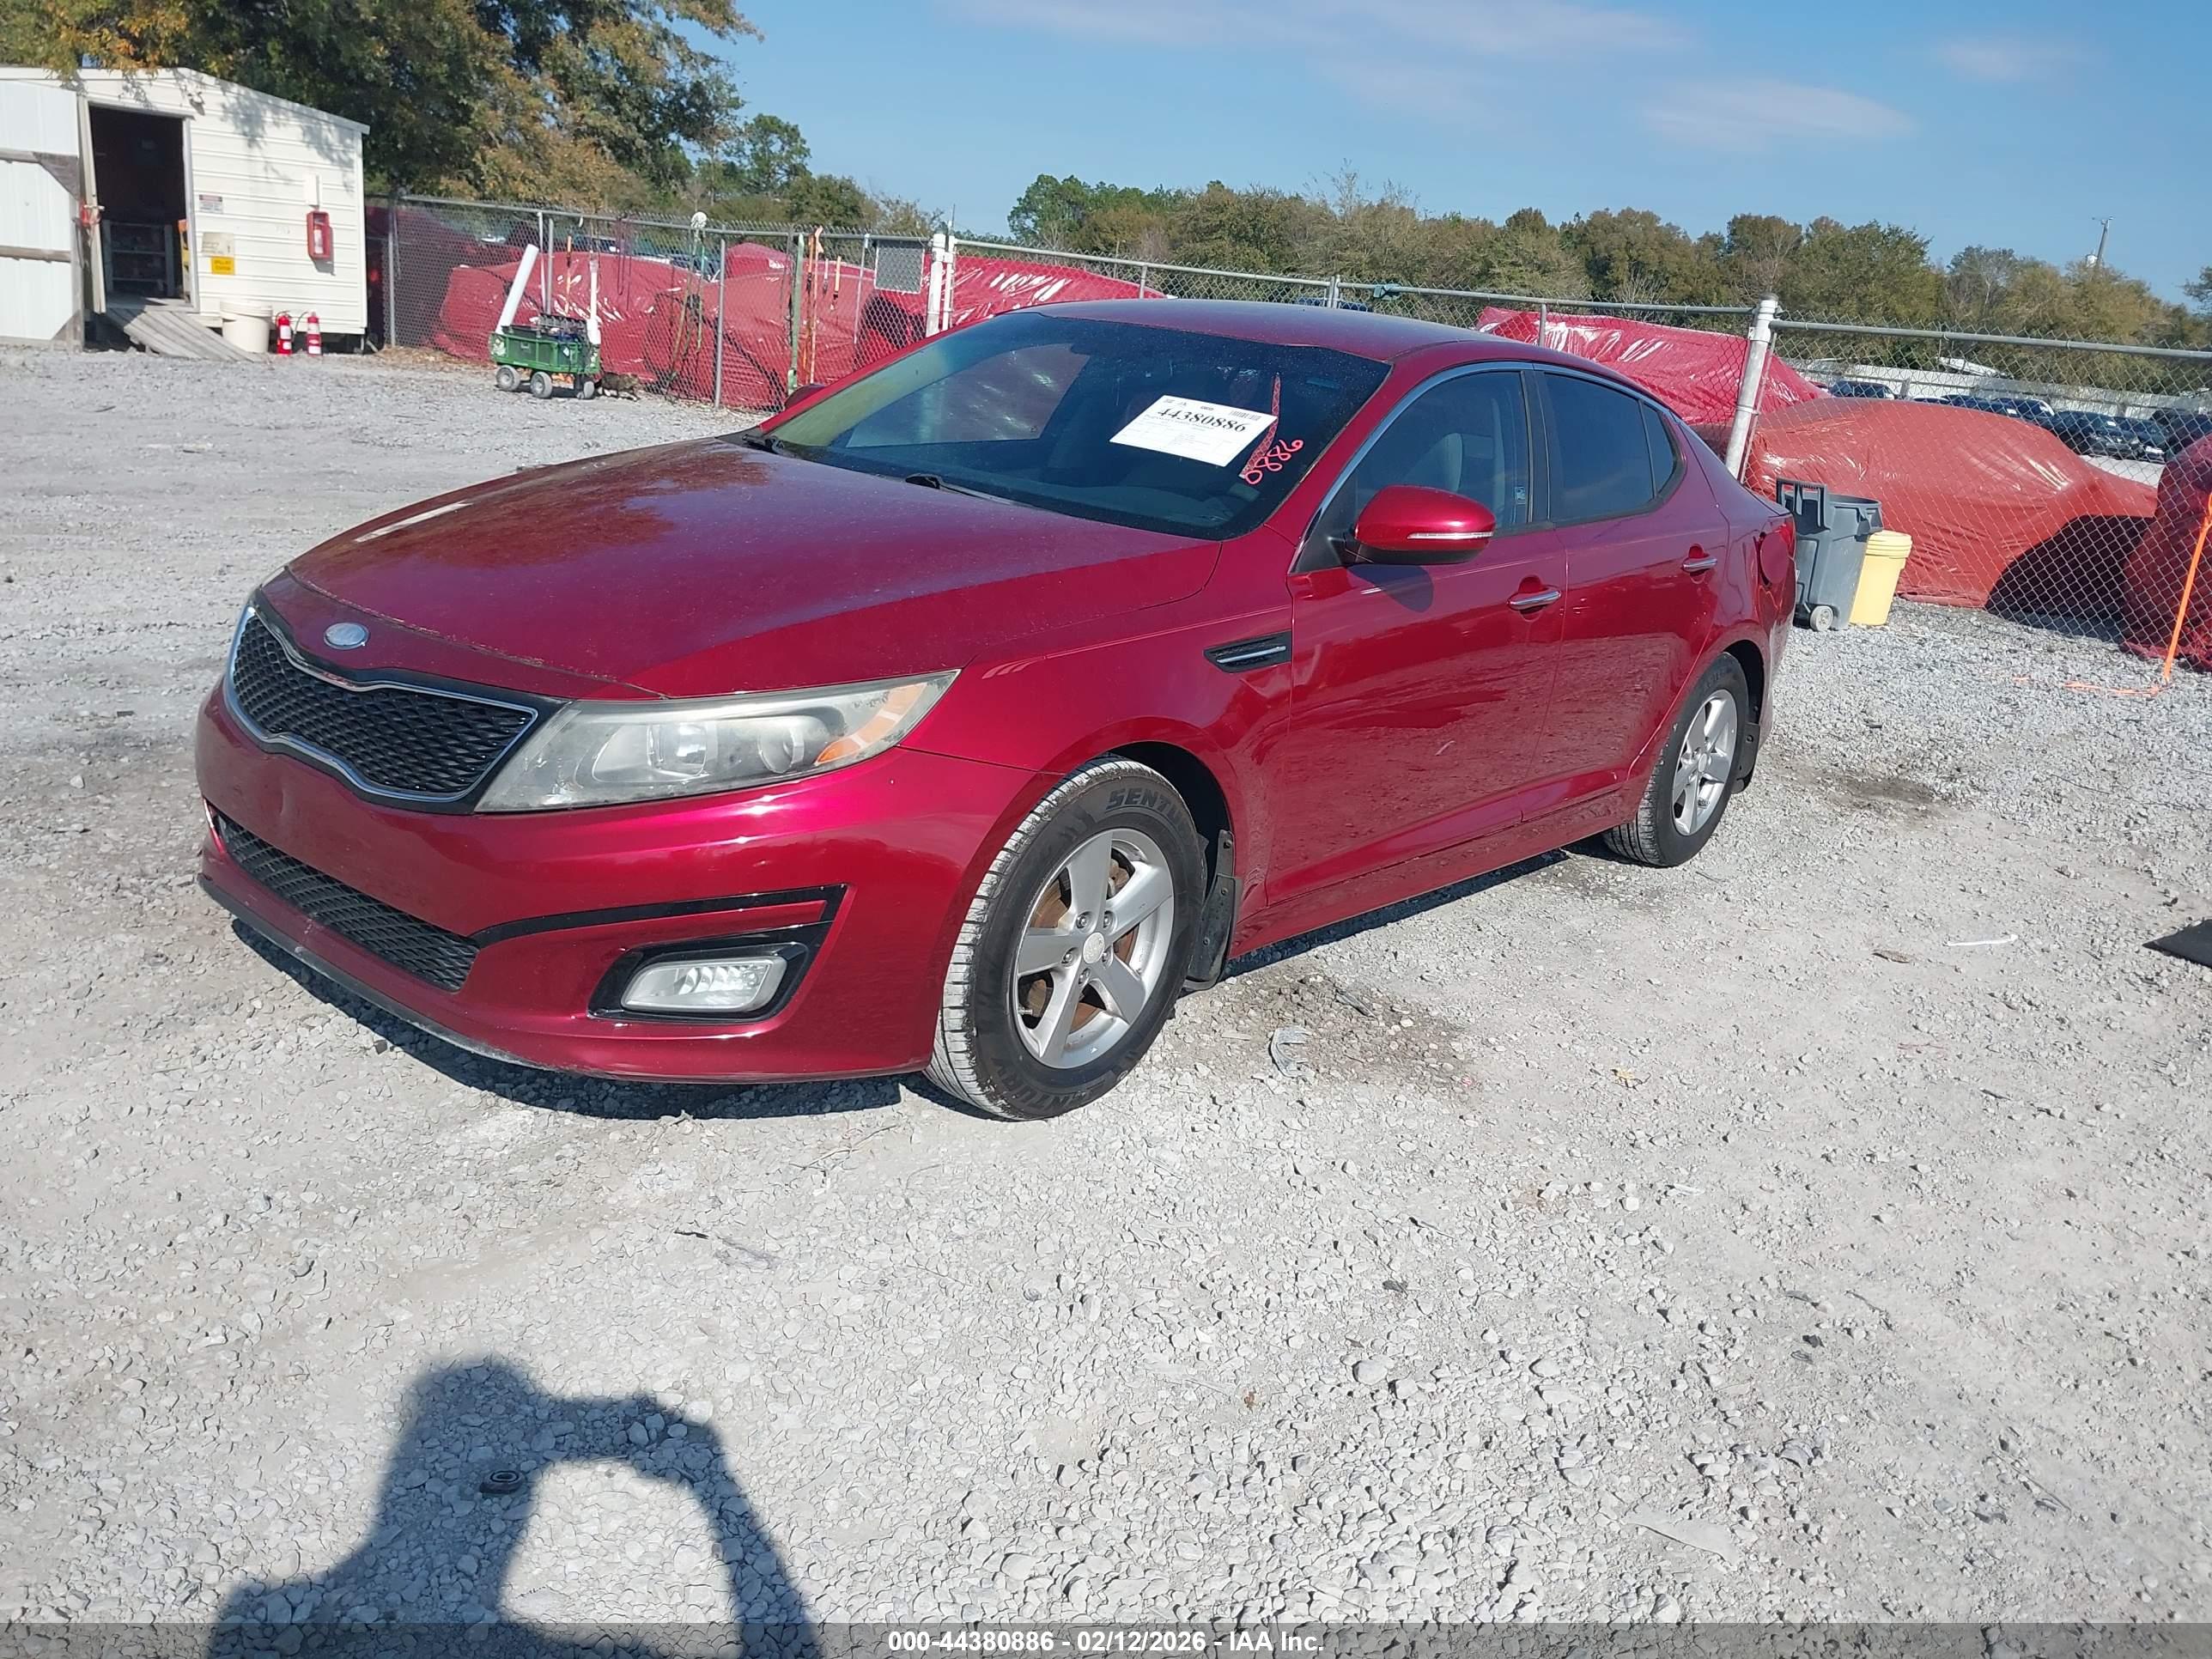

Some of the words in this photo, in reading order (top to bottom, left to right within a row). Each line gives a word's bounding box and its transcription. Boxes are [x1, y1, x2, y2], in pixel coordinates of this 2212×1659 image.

[1158, 408, 1249, 433] 44380886
[1245, 439, 1304, 484] 0886
[1105, 787, 1190, 833] SENTU
